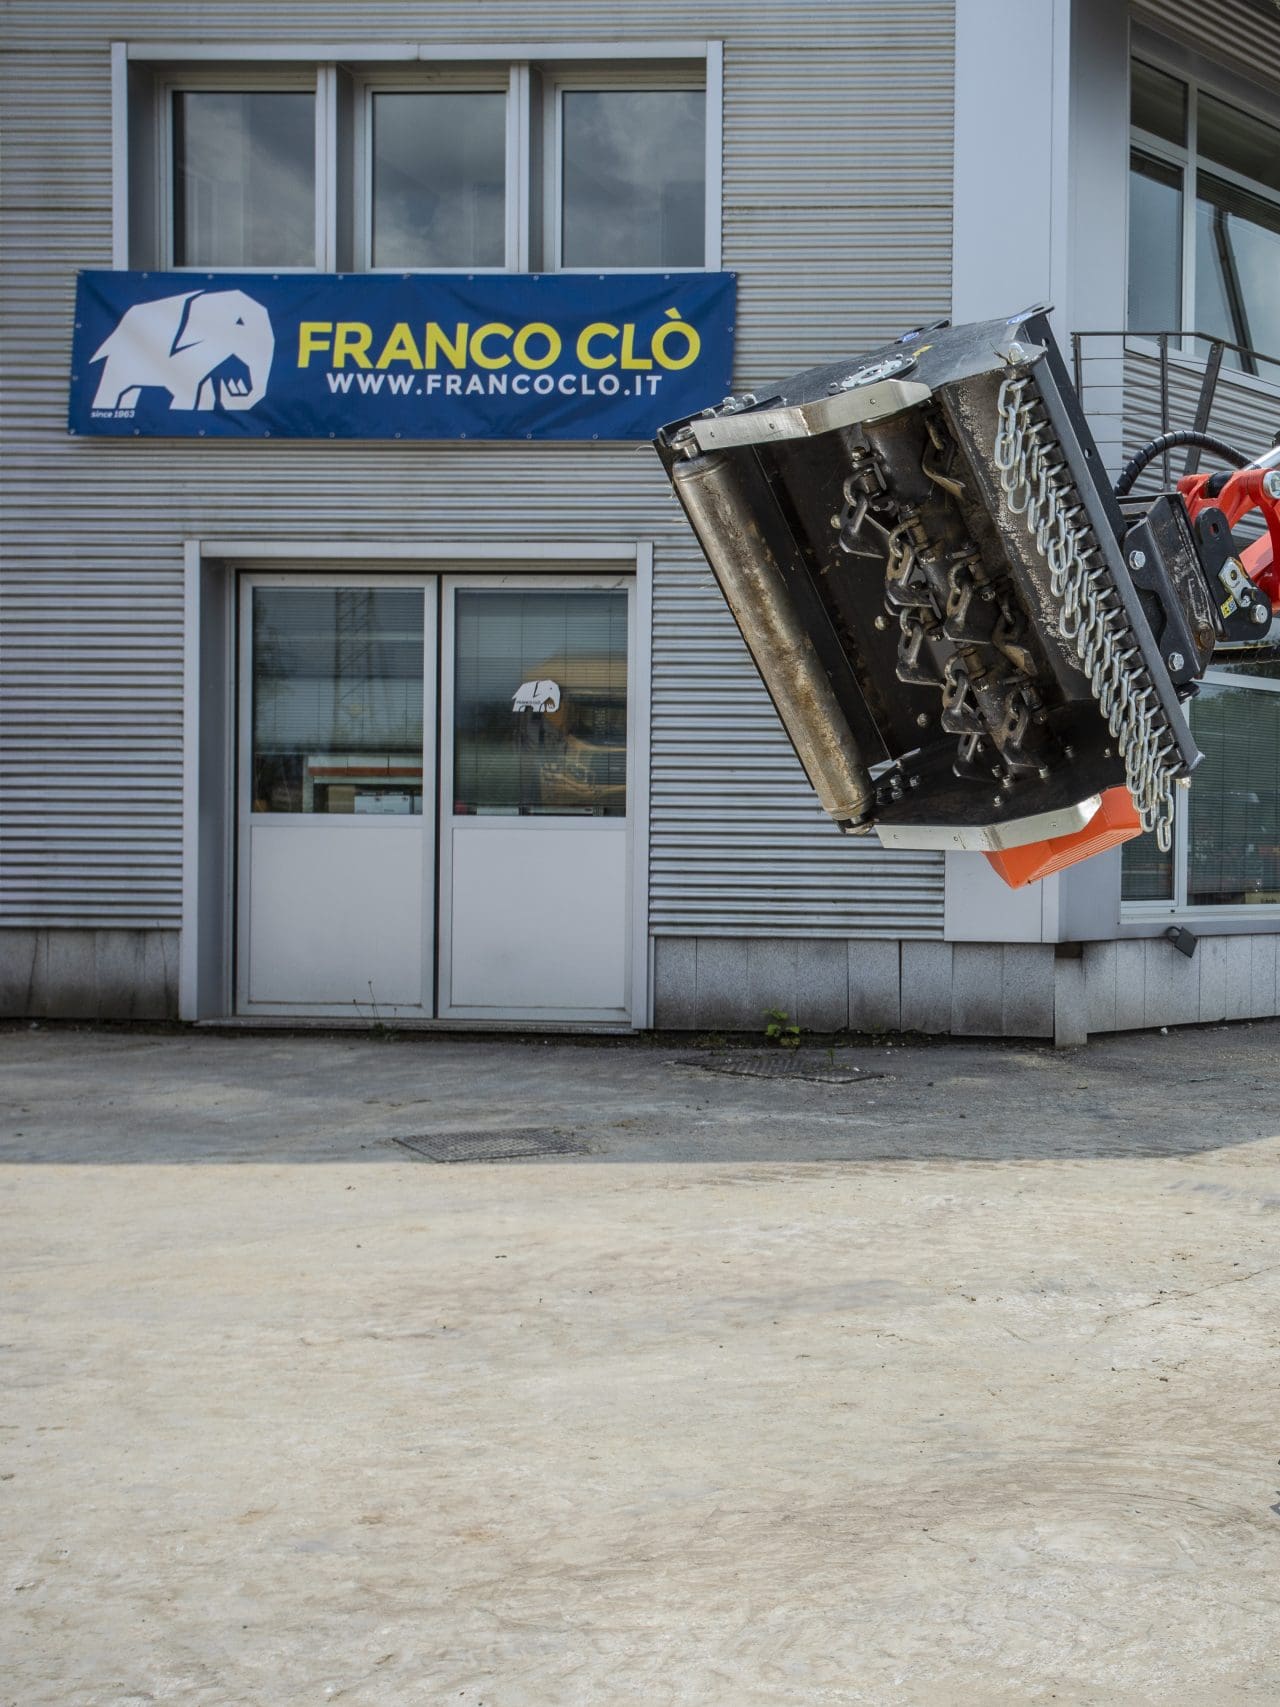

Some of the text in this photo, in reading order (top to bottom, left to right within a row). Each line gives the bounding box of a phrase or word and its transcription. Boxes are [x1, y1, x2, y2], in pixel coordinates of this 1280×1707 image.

[297, 308, 701, 371] FRANCO CLÒ
[326, 372, 663, 397] WWW.FRANCOCLO.IT
